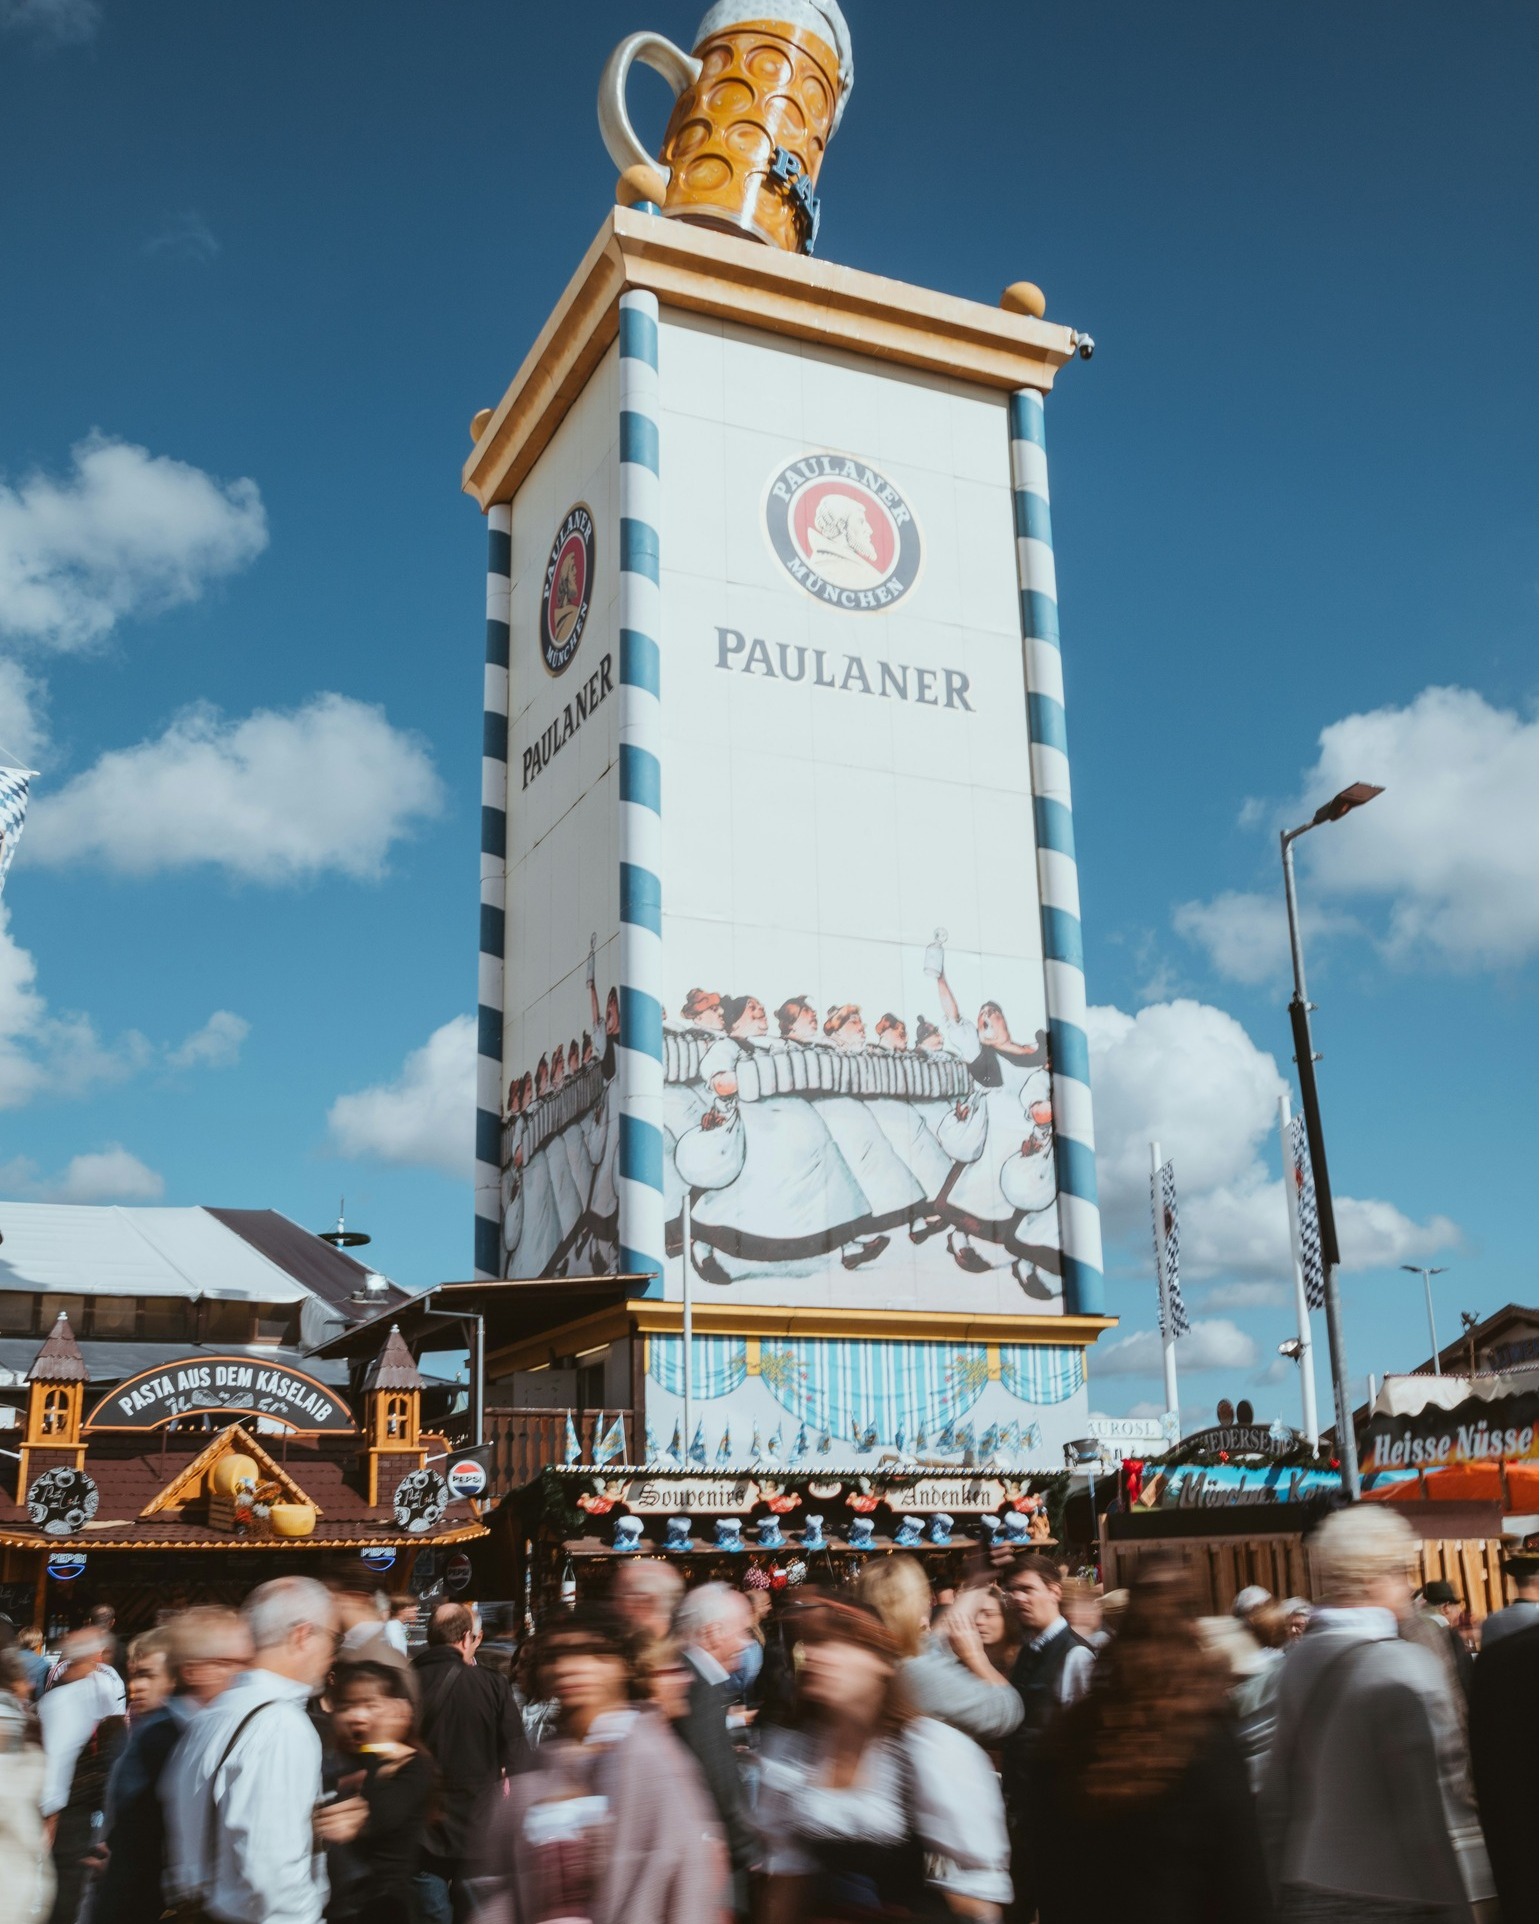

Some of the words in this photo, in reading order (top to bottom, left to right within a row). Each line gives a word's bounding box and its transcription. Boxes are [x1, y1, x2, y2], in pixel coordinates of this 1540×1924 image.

[772, 456, 911, 527] PAULANER
[543, 509, 592, 600] PAULANER
[786, 557, 905, 608] MÜNCHEN
[546, 601, 588, 670] MÜNCHEN
[714, 625, 977, 713] PAULANER
[522, 652, 614, 792] PAULANER
[117, 1375, 175, 1417] PASTA
[178, 1366, 212, 1391] AUS
[215, 1366, 253, 1388] DEM
[255, 1370, 333, 1423] KÄSELAIB
[1374, 1430, 1451, 1467] Heisse
[1456, 1419, 1534, 1460] Nüsse
[452, 1475, 482, 1483] PEPSI
[639, 1481, 745, 1508] Souvenirs
[901, 1484, 992, 1506] Andenken
